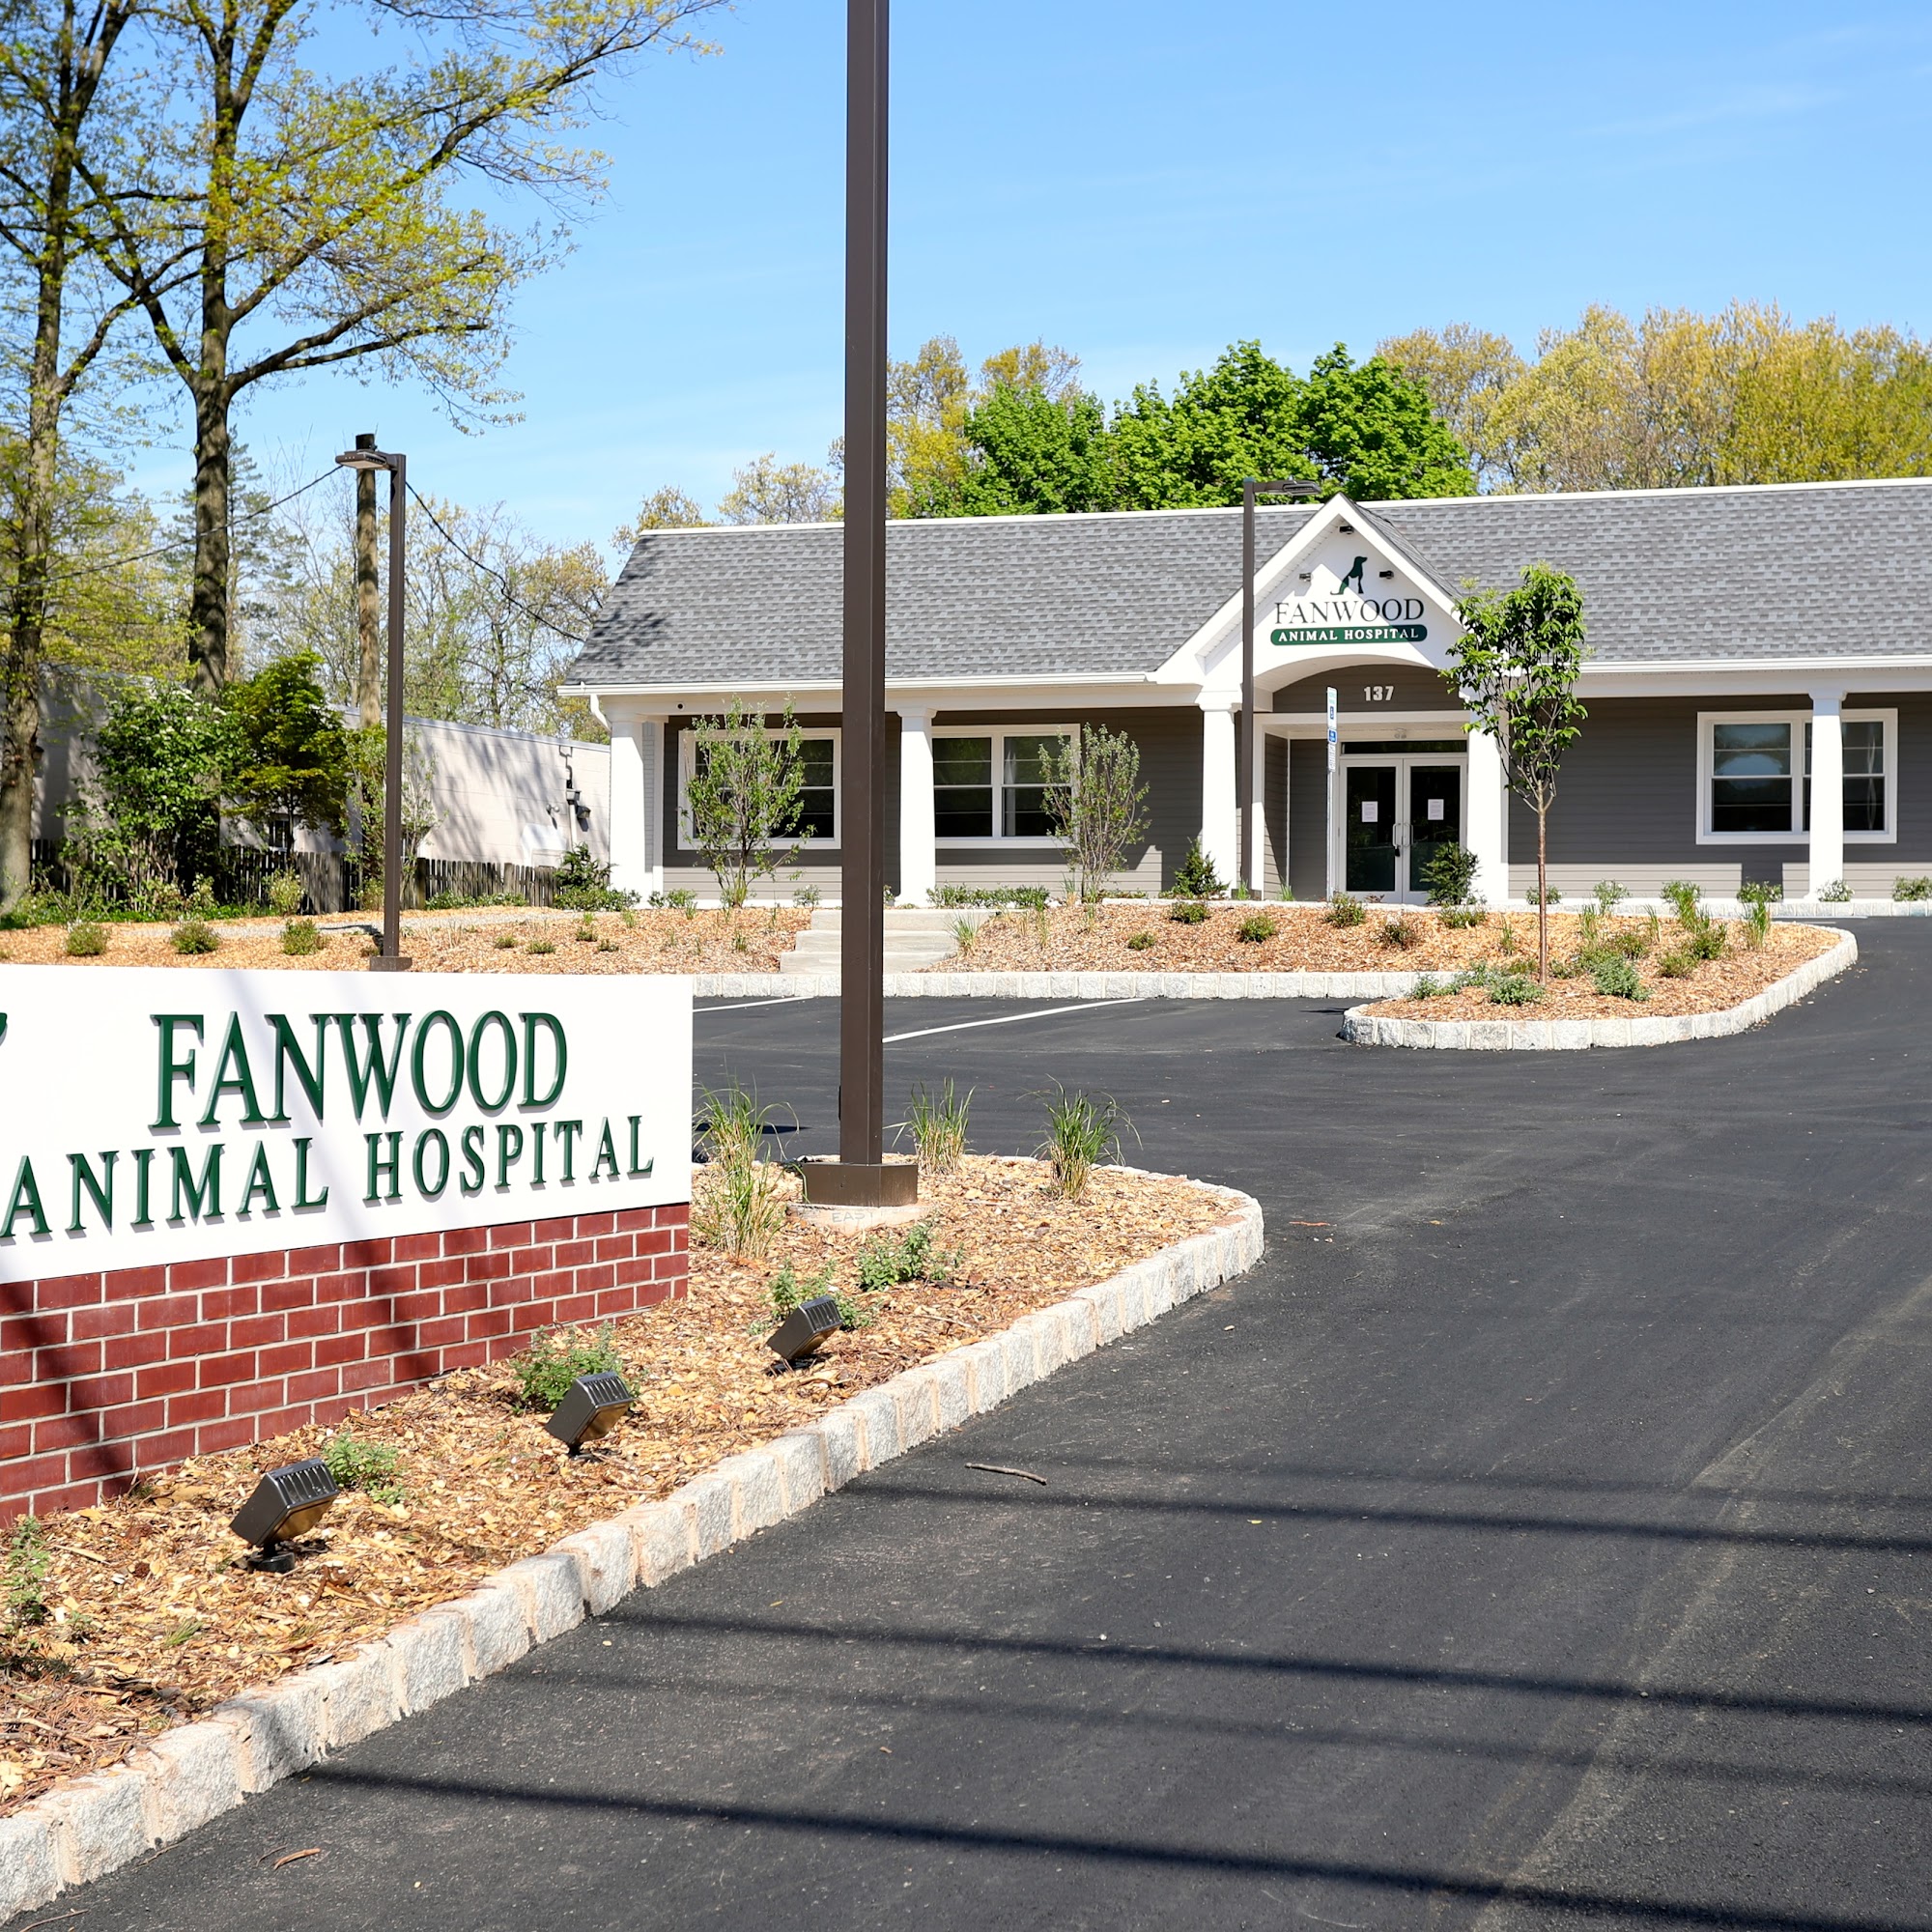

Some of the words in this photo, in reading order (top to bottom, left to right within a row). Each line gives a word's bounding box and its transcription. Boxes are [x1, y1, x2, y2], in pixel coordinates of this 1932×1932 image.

[1274, 598, 1425, 625] FANWOOD
[1277, 630, 1338, 642] ANIMAL
[1344, 628, 1419, 640] HOSPITAL
[1363, 685, 1395, 702] 137
[148, 1009, 568, 1130] FANWOOD
[0, 1136, 329, 1240] ANIMAL
[363, 1115, 654, 1203] HOSPITAL
